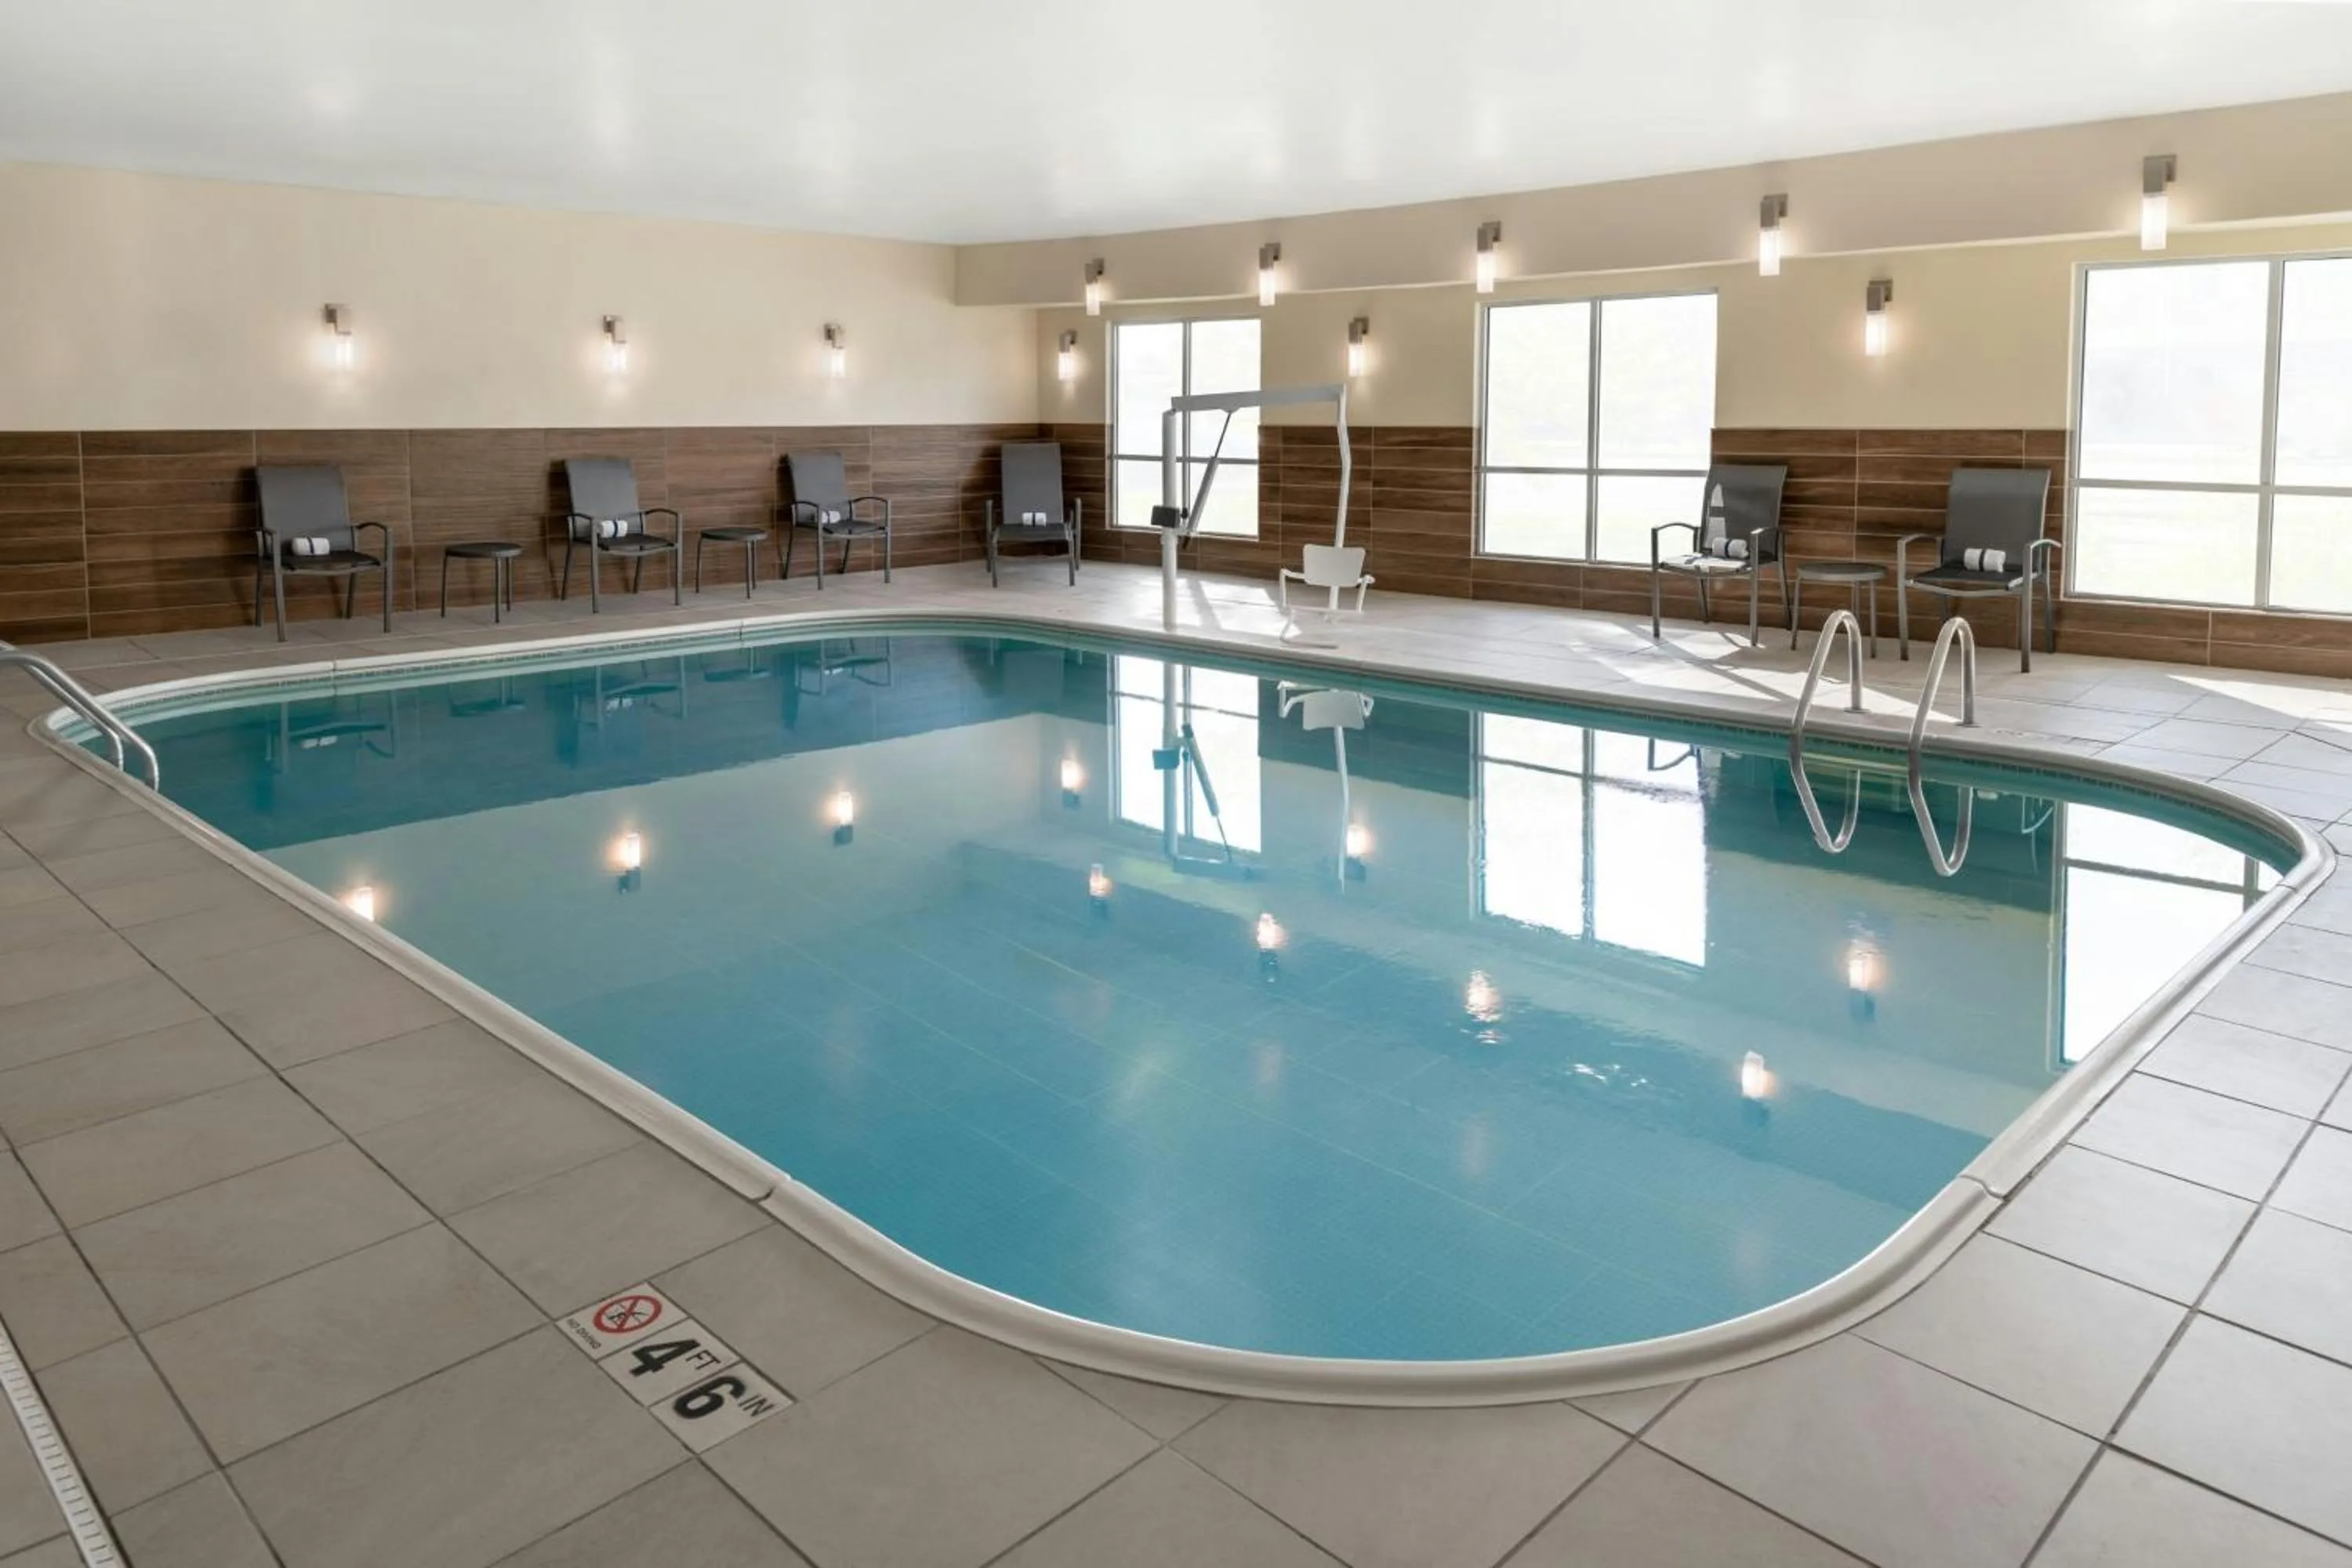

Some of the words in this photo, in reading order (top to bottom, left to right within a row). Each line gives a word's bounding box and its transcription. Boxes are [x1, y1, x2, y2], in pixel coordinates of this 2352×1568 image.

[566, 1318, 581, 1329] NO
[576, 1327, 602, 1349] DIVING
[630, 1339, 700, 1377] 4
[685, 1349, 720, 1370] FT
[673, 1375, 746, 1420] 6
[738, 1395, 775, 1417] IN
